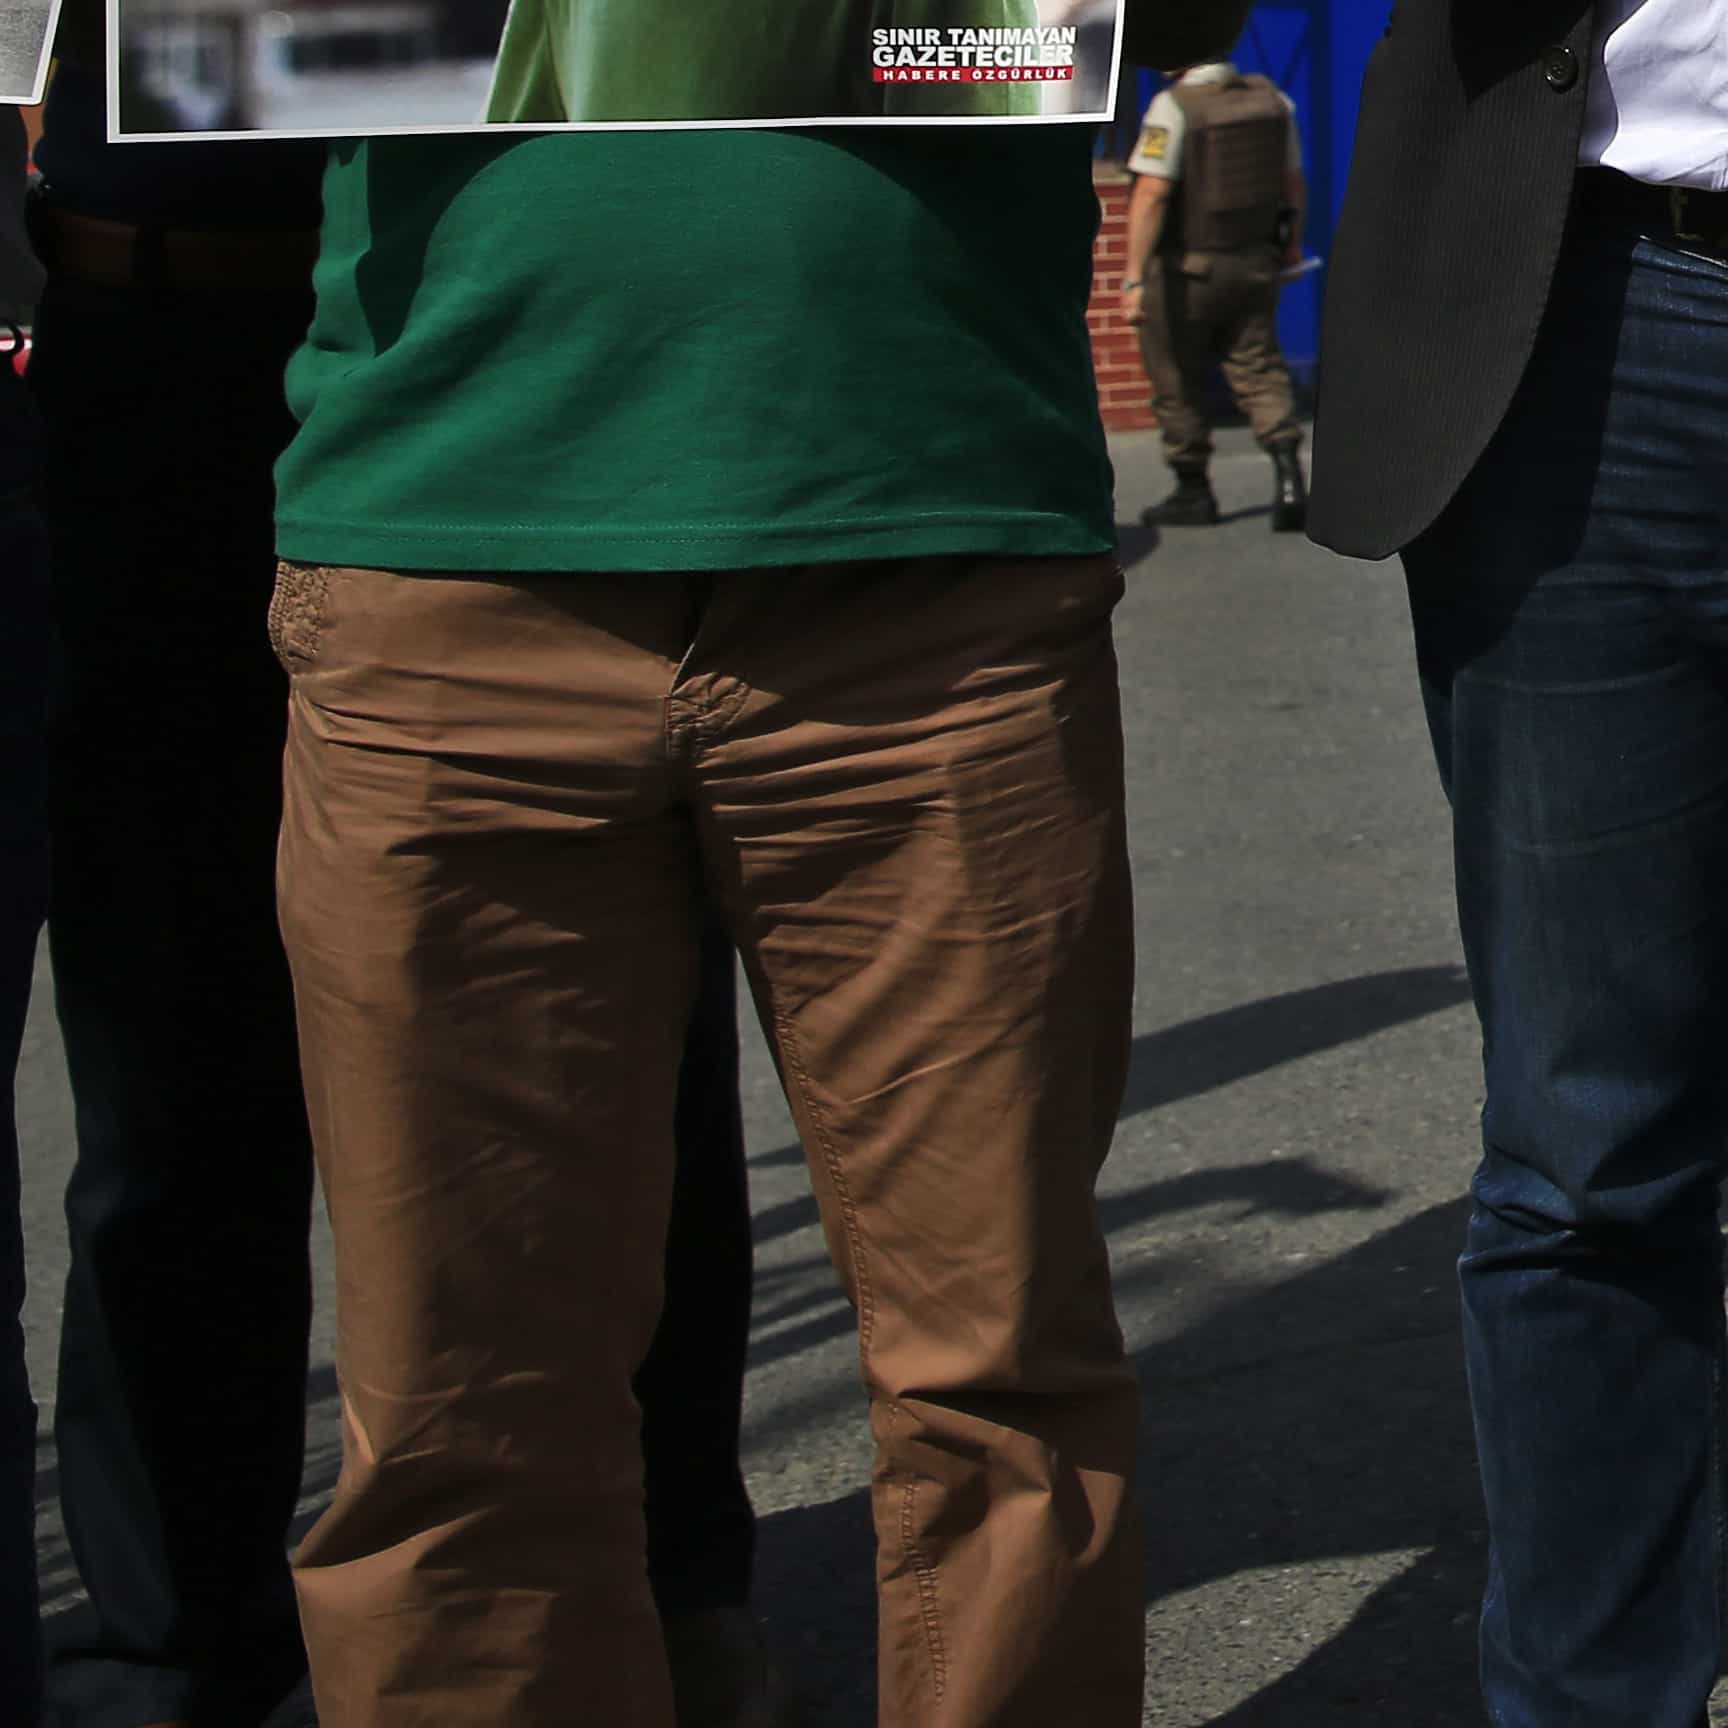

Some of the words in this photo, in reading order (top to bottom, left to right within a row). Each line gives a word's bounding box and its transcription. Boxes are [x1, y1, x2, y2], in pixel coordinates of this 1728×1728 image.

[873, 28, 941, 46] SINIR
[947, 26, 1077, 46] TANIMAYAN
[883, 70, 961, 80] HABERE
